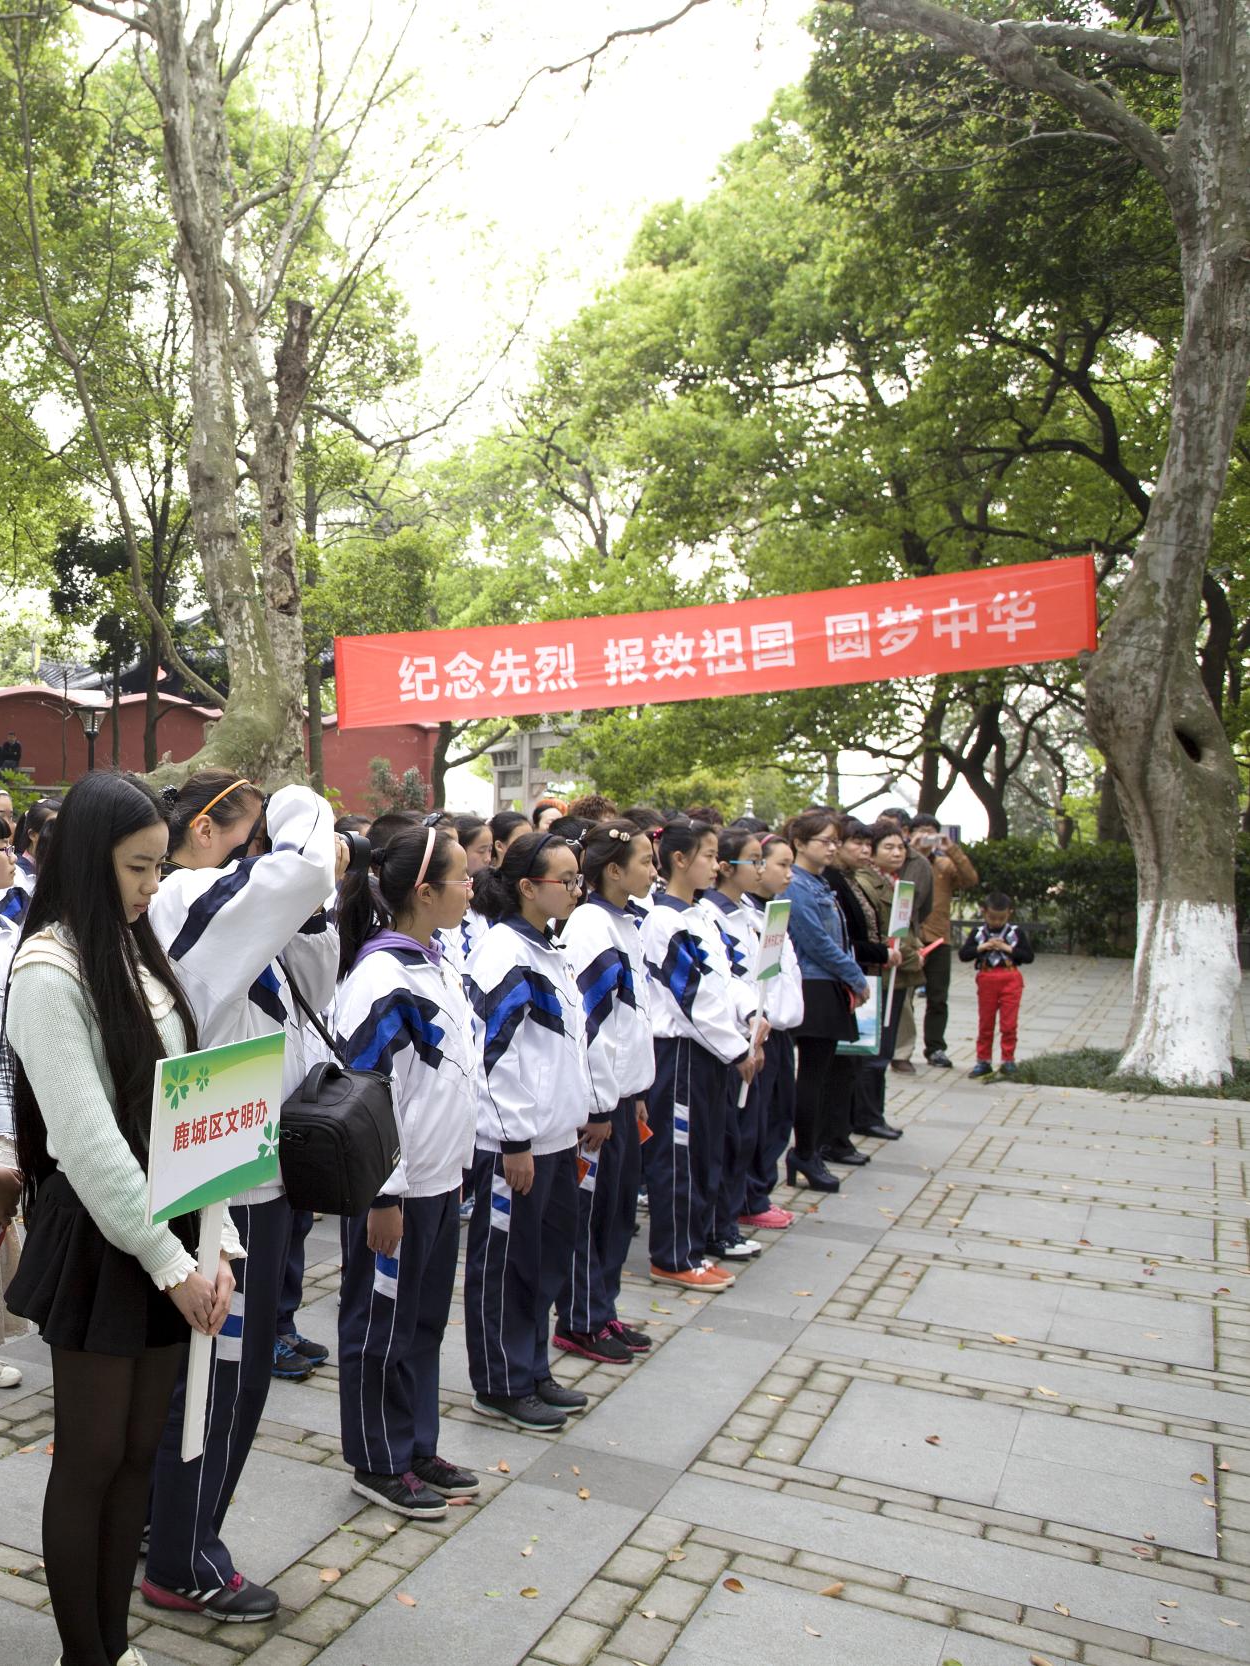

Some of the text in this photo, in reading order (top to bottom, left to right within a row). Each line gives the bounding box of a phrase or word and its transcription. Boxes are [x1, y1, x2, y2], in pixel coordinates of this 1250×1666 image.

[397, 591, 1037, 703] 纪念先烈 报效祖国 圆梦中华
[172, 1098, 268, 1152] 鹿城区文明办
